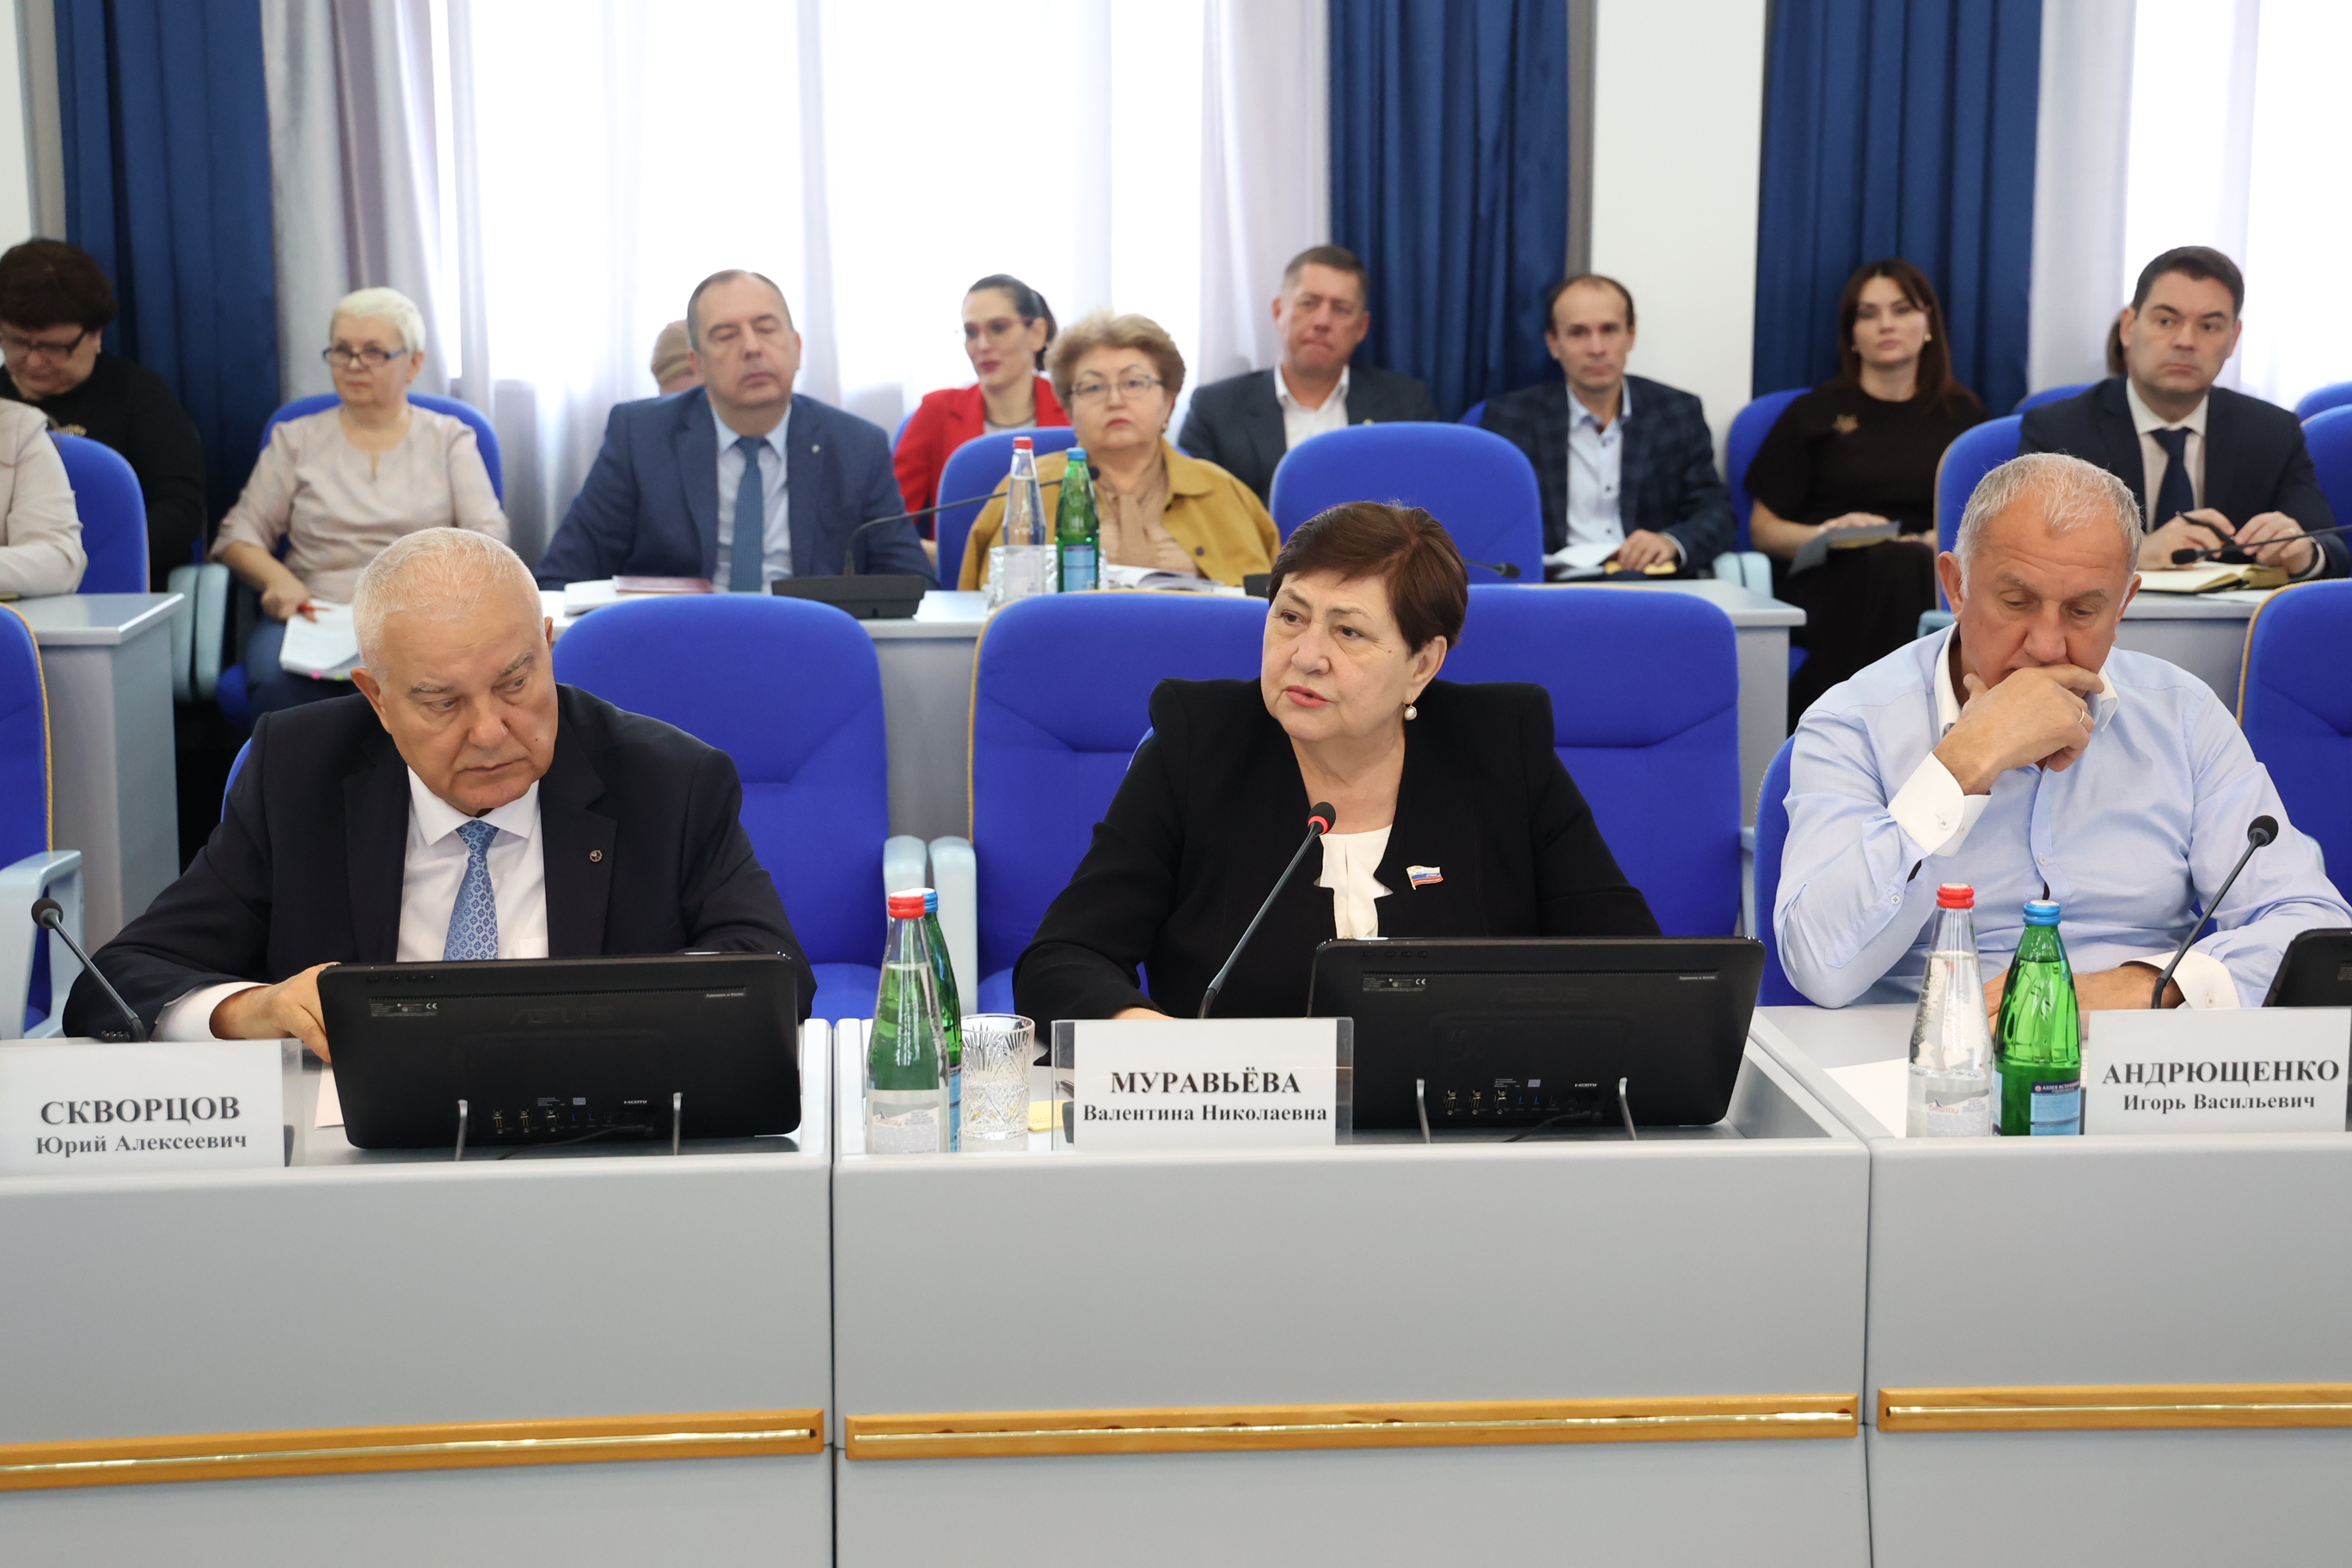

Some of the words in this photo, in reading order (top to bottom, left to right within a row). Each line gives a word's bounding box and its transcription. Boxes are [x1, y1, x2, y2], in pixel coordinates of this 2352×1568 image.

[509, 1006, 616, 1024] ASUS
[1110, 1066, 1302, 1094] МУРАВЬЁВА
[2103, 1060, 2339, 1087] АНДРЮЩЕНКО
[40, 1096, 242, 1126] СКВОРЦОВ
[1083, 1104, 1195, 1121] Валентина
[1201, 1104, 1328, 1121] Николаевна
[2122, 1095, 2186, 1114] Игорь
[2193, 1094, 2316, 1110] Васильевич
[36, 1136, 107, 1158] Юрий
[114, 1135, 248, 1152] Алексеевич
